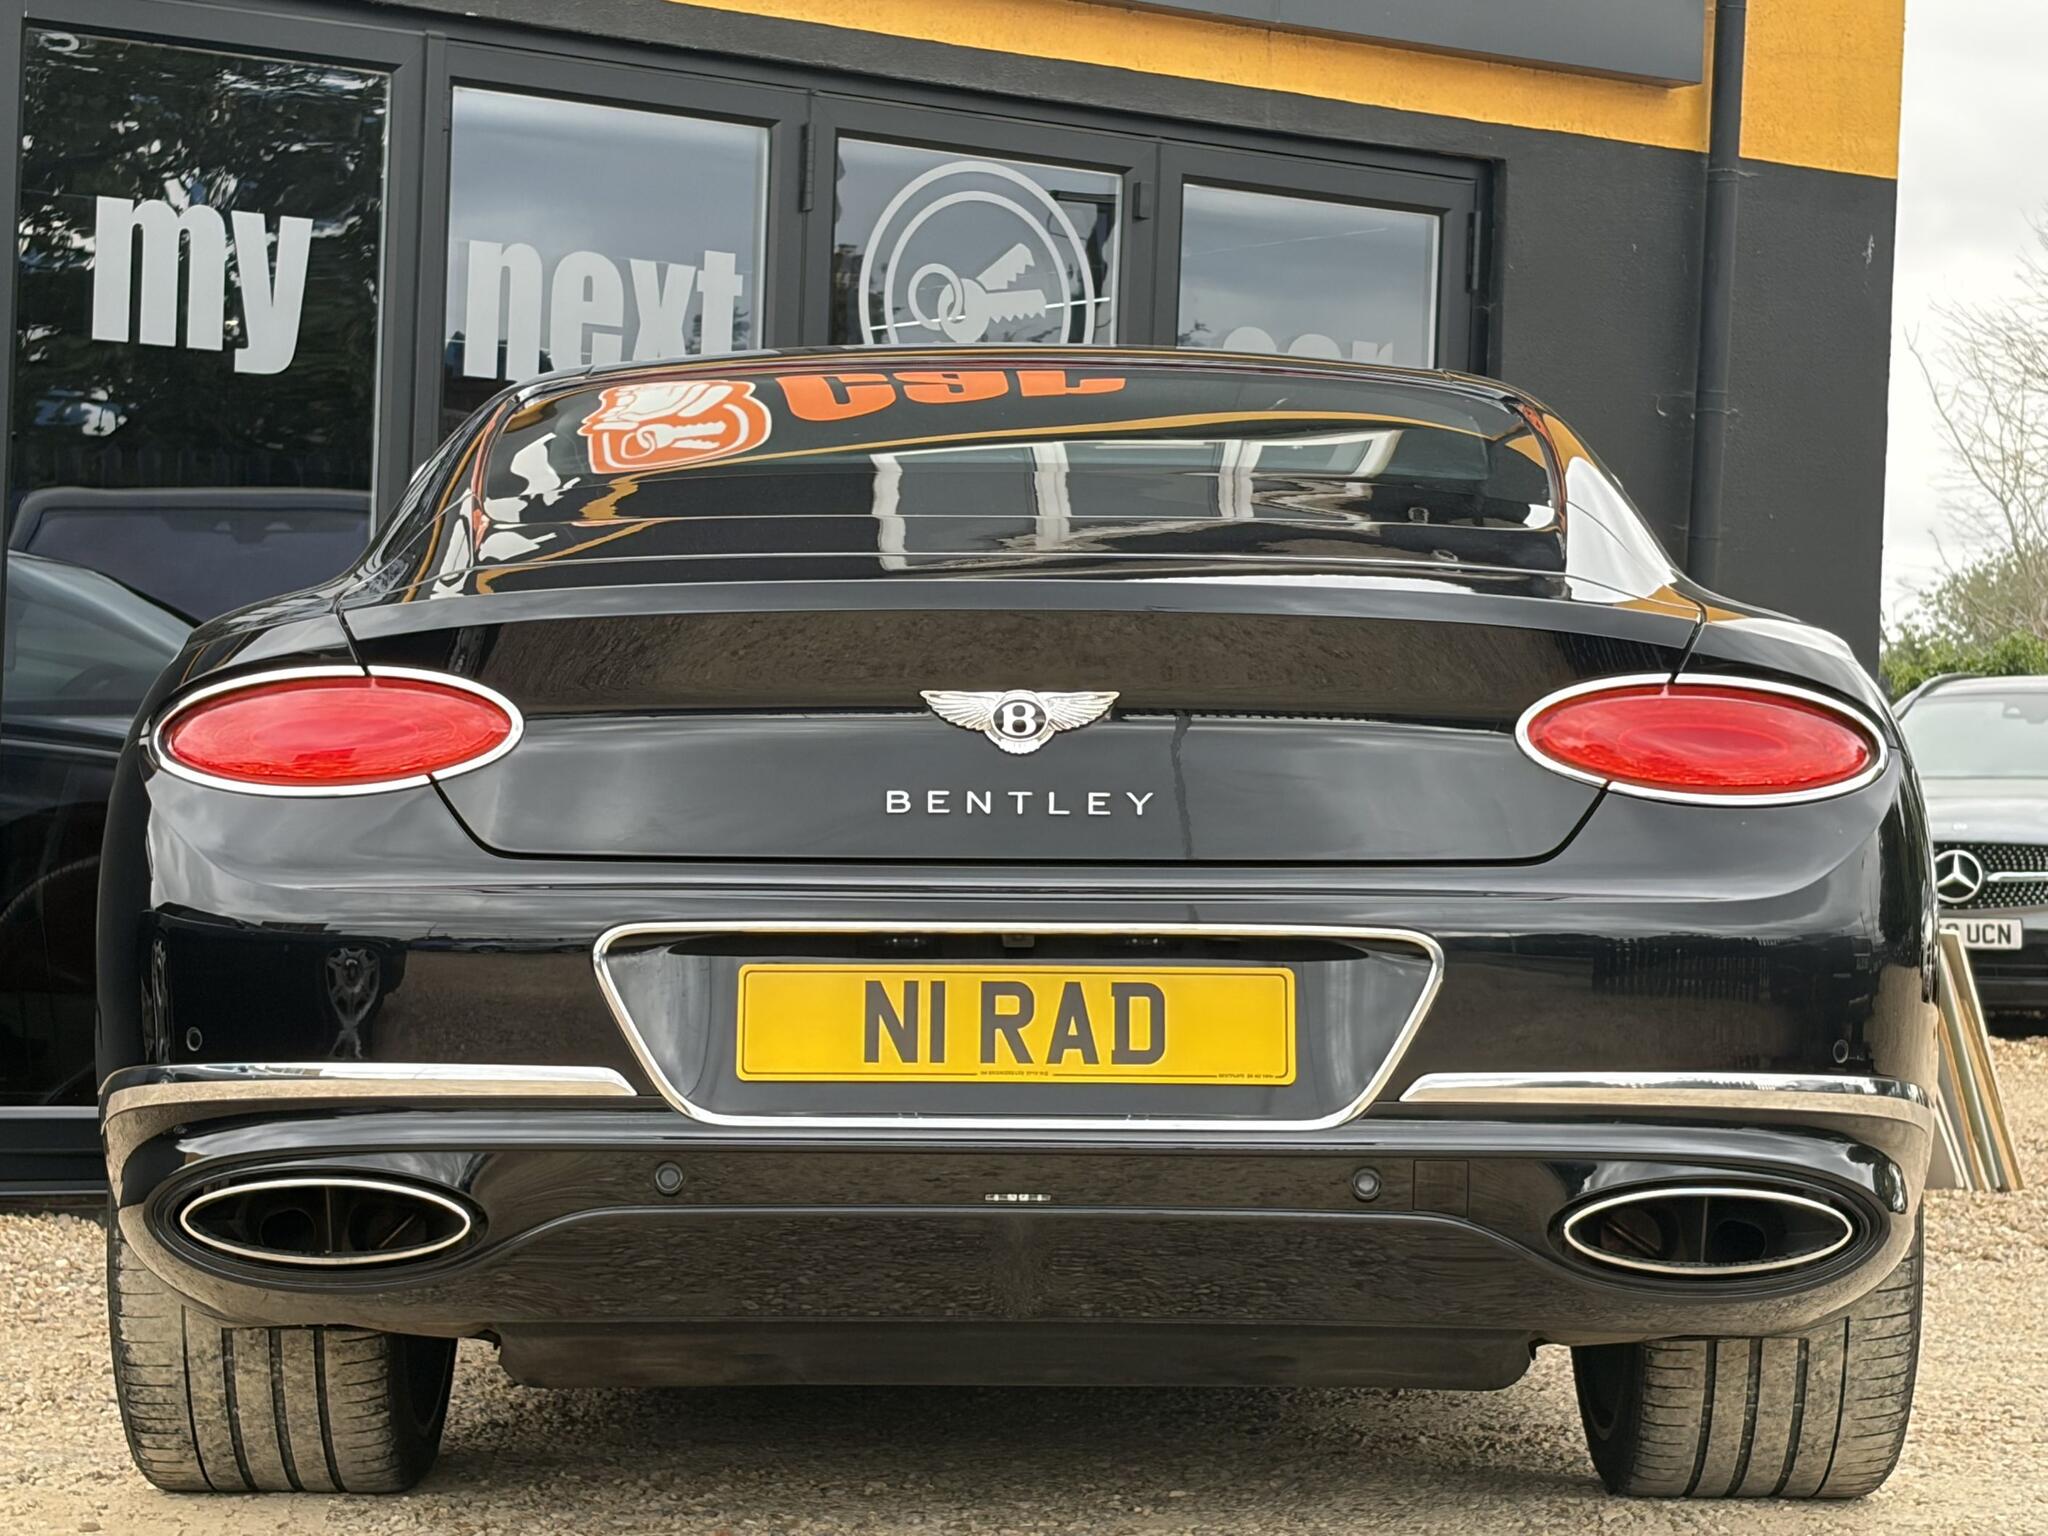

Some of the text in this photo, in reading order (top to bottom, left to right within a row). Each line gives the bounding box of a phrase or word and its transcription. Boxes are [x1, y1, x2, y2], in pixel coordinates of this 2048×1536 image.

[92, 195, 743, 382] my next
[1002, 704, 1036, 736] B
[886, 790, 1154, 816] BENTLEY
[1967, 923, 2012, 945] UCN
[980, 981, 1166, 1065] RAD
